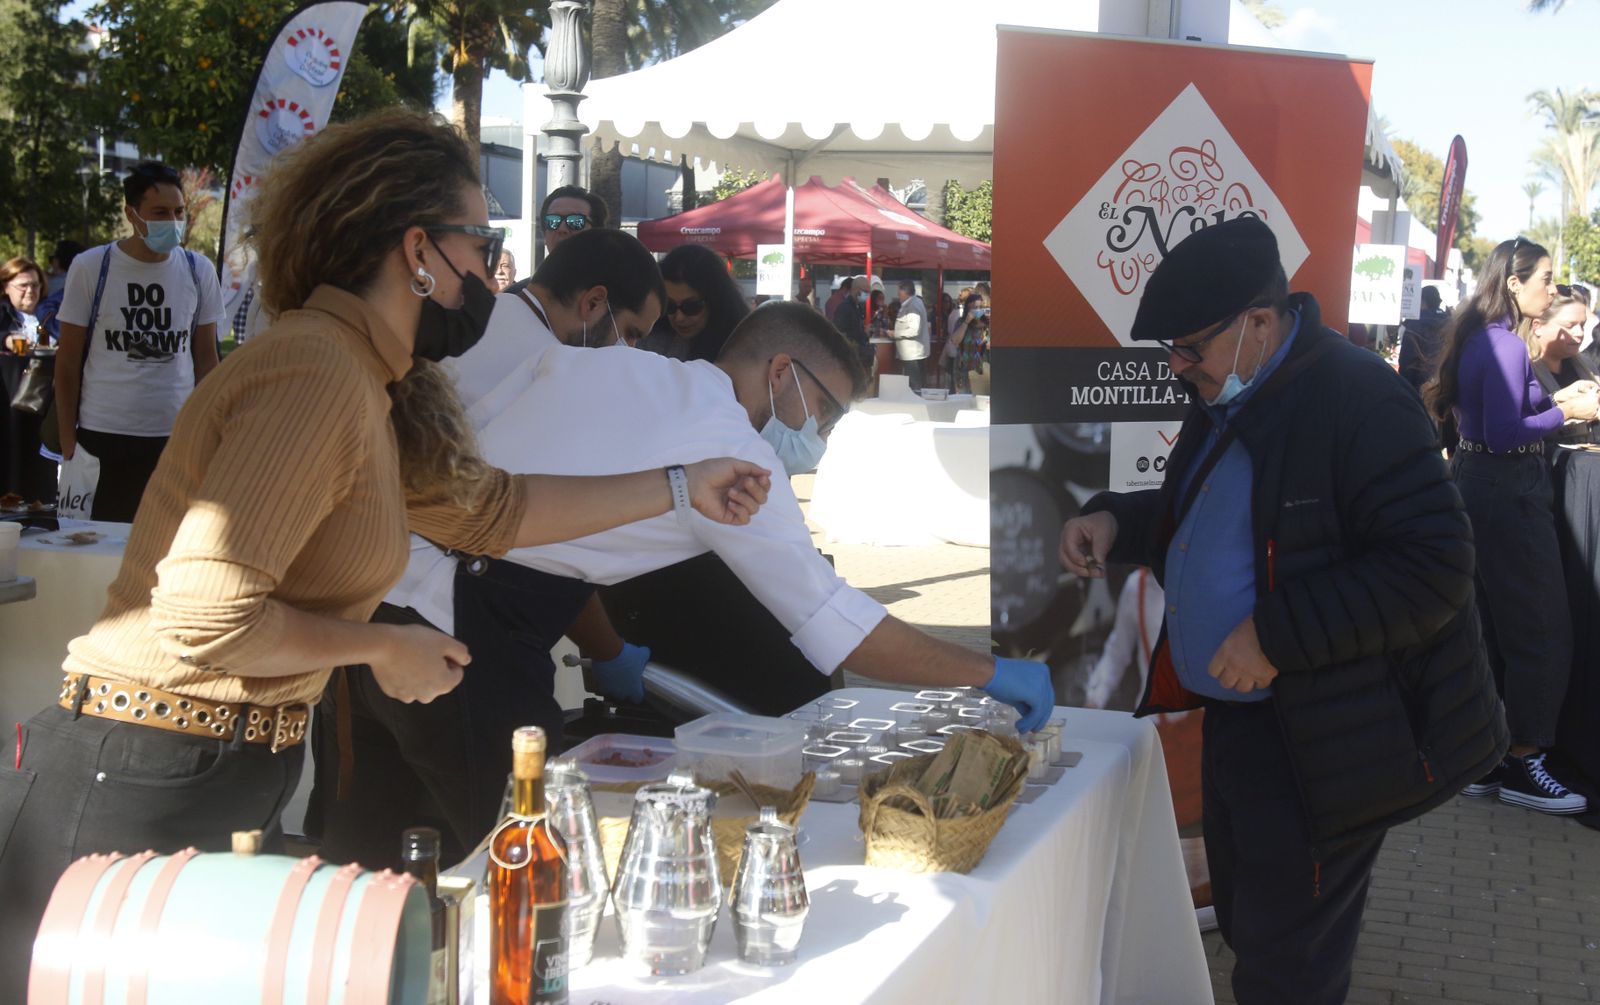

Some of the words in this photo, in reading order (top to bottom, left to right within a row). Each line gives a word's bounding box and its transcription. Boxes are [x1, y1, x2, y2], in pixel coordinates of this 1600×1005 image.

[680, 226, 721, 235] Cruzcampo
[127, 283, 165, 307] DO
[120, 307, 171, 331] YOU
[105, 329, 188, 353] KNOW?
[1097, 361, 1151, 381] CASA
[1070, 385, 1192, 405] MONTILLA-
